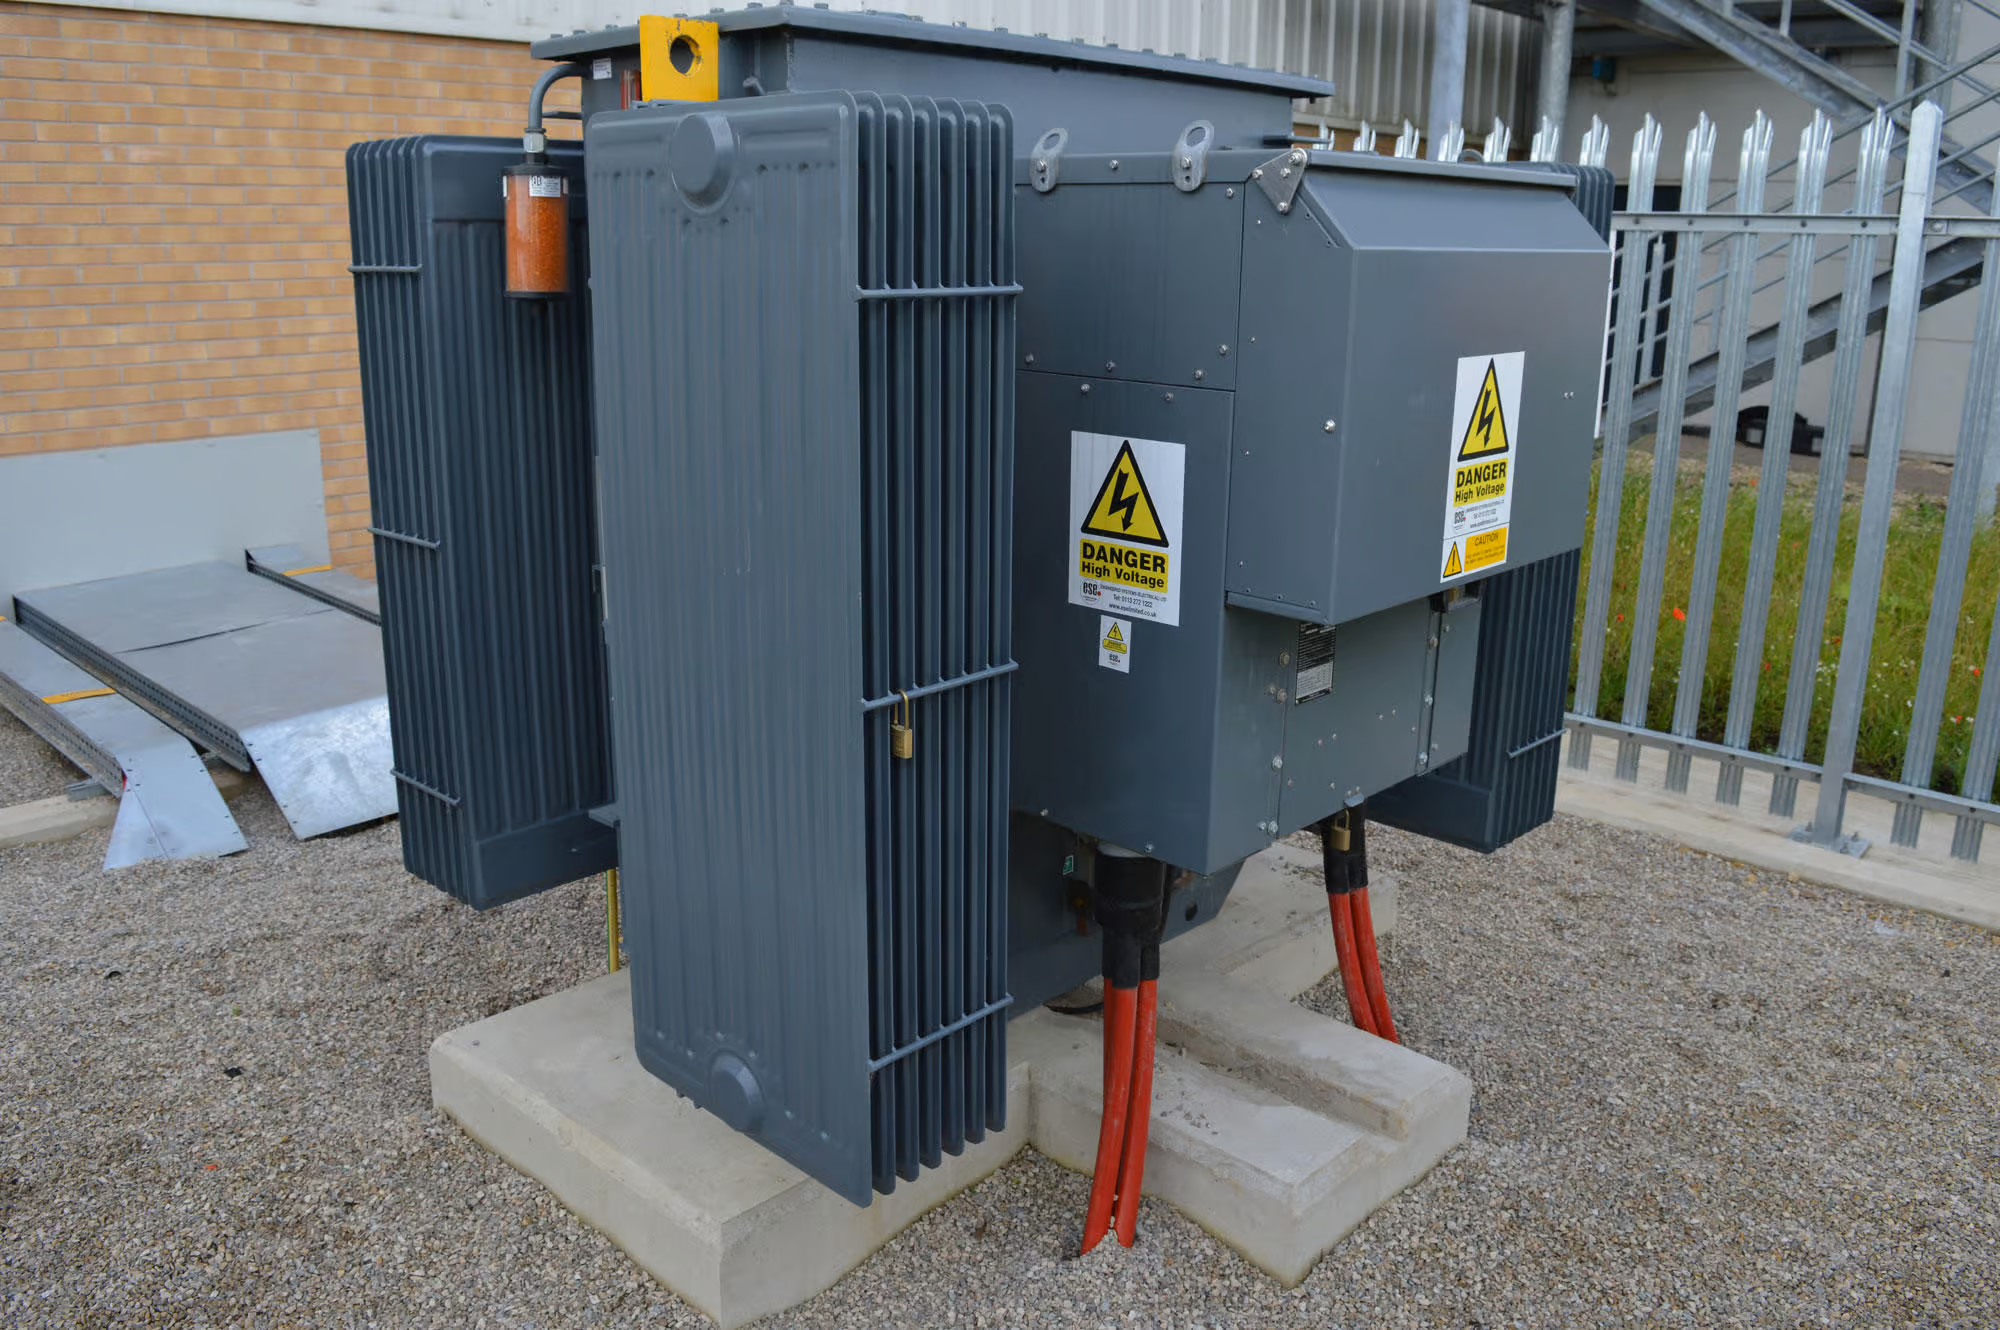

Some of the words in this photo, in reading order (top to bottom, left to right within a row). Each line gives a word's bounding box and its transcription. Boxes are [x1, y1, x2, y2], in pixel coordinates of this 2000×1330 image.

[1456, 461, 1506, 488] DANGER
[1455, 488, 1474, 503] High
[1476, 482, 1505, 497] Voltage
[1082, 541, 1166, 574] DANGER
[1082, 561, 1110, 578] High
[1115, 567, 1165, 589] Voltage
